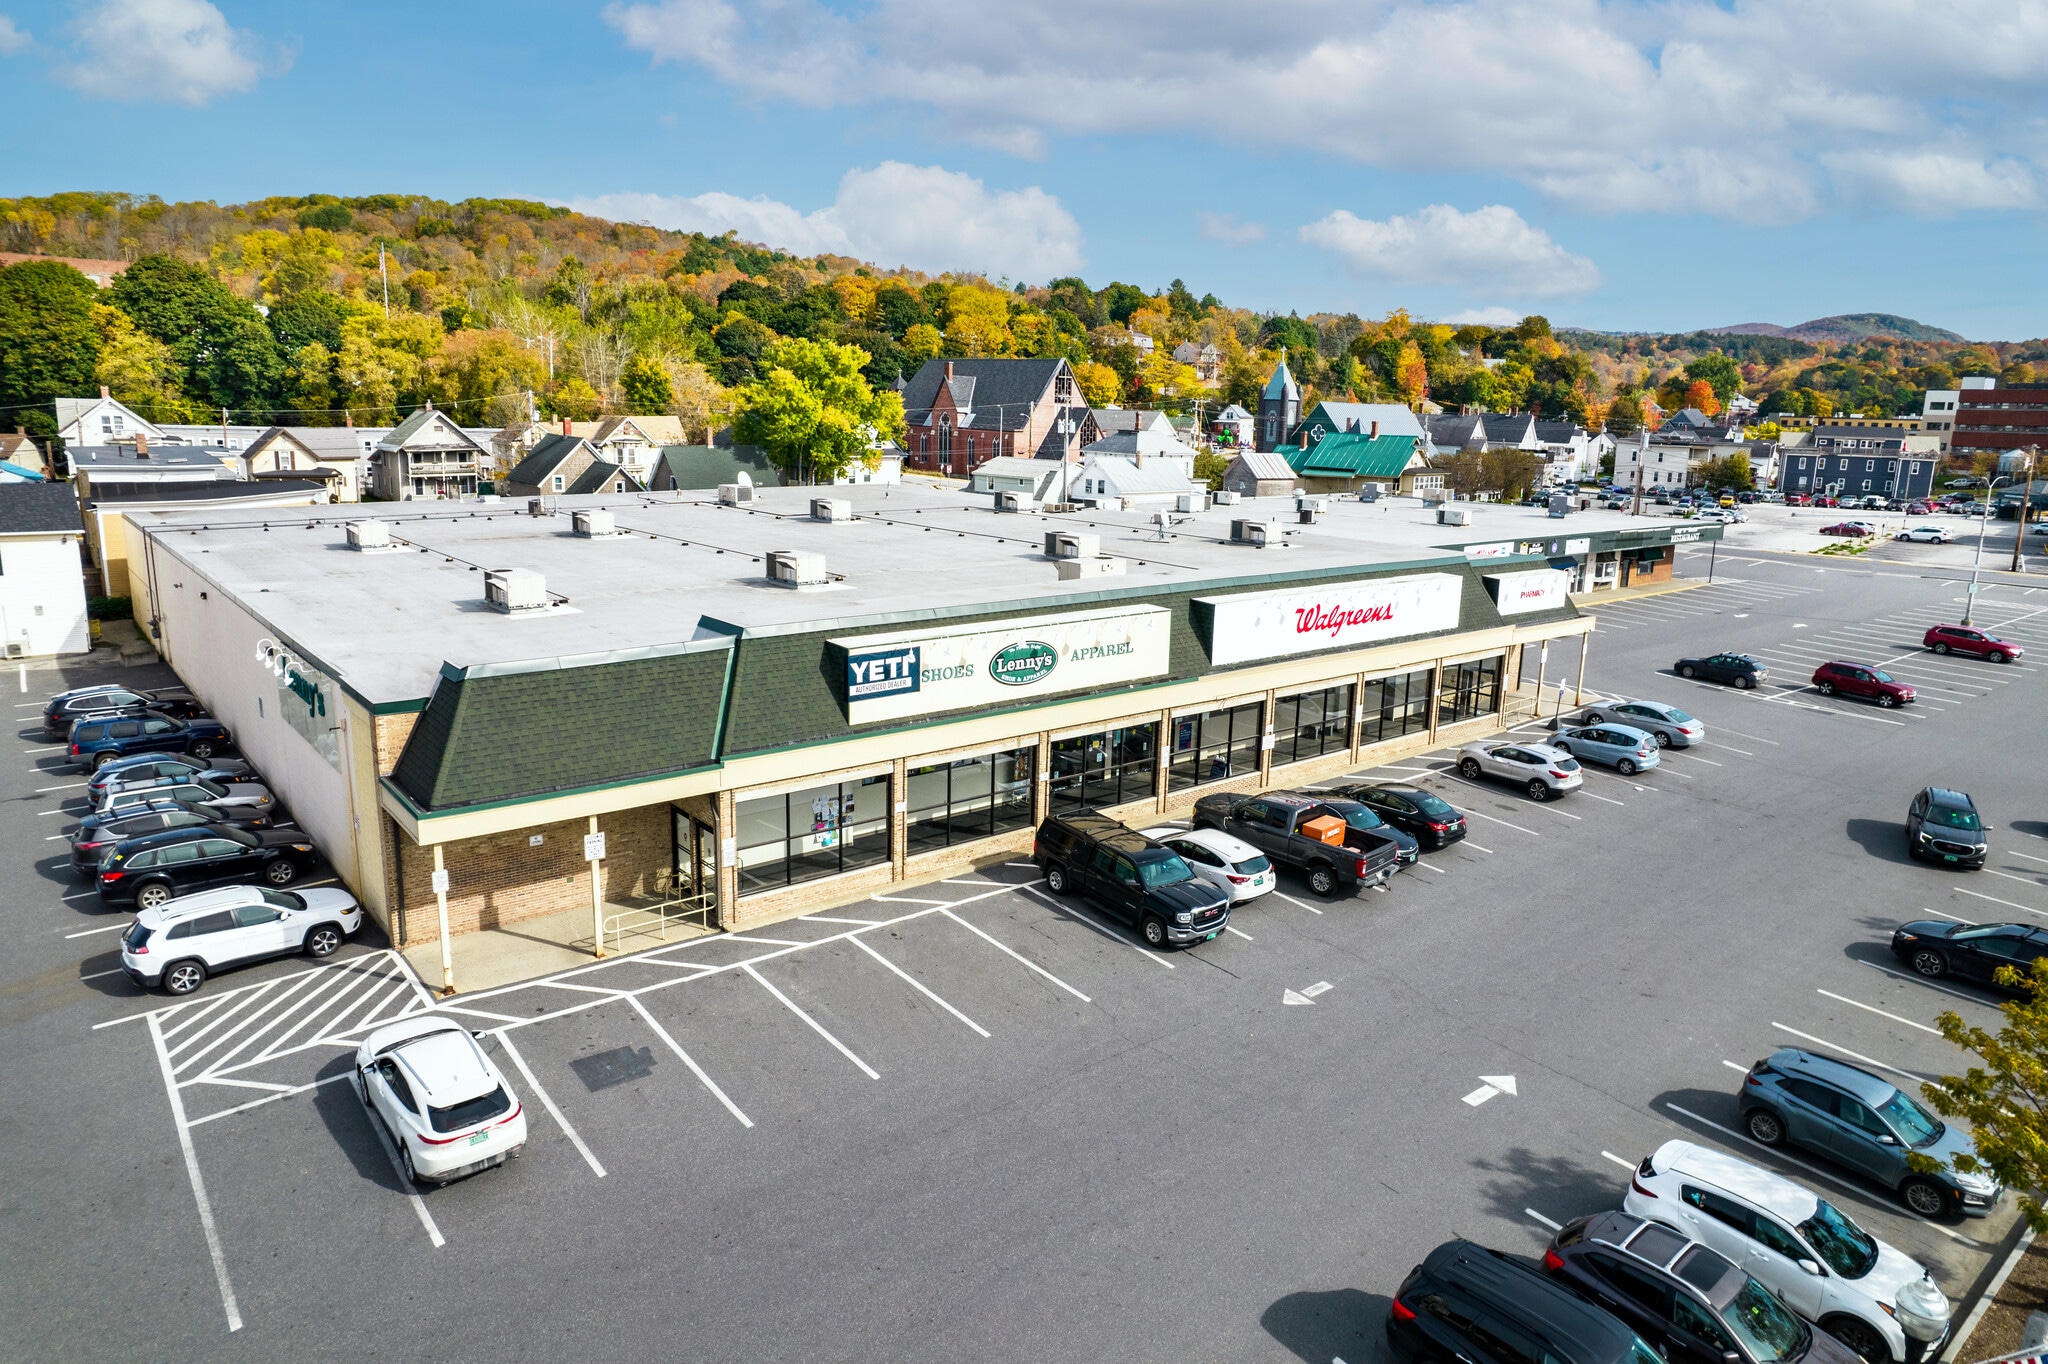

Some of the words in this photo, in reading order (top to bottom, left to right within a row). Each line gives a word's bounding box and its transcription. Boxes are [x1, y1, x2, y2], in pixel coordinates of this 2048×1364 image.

[1520, 589, 1545, 599] PHARMACY
[1295, 603, 1393, 638] Walgreens
[1070, 641, 1134, 661] APPAREL
[850, 655, 909, 684] YETI
[996, 652, 1053, 673] Lenny's
[921, 664, 974, 683] SHOES
[1023, 669, 1048, 681] APPAREL
[855, 682, 887, 693] AUTHORIZED
[887, 680, 907, 689] DEALER
